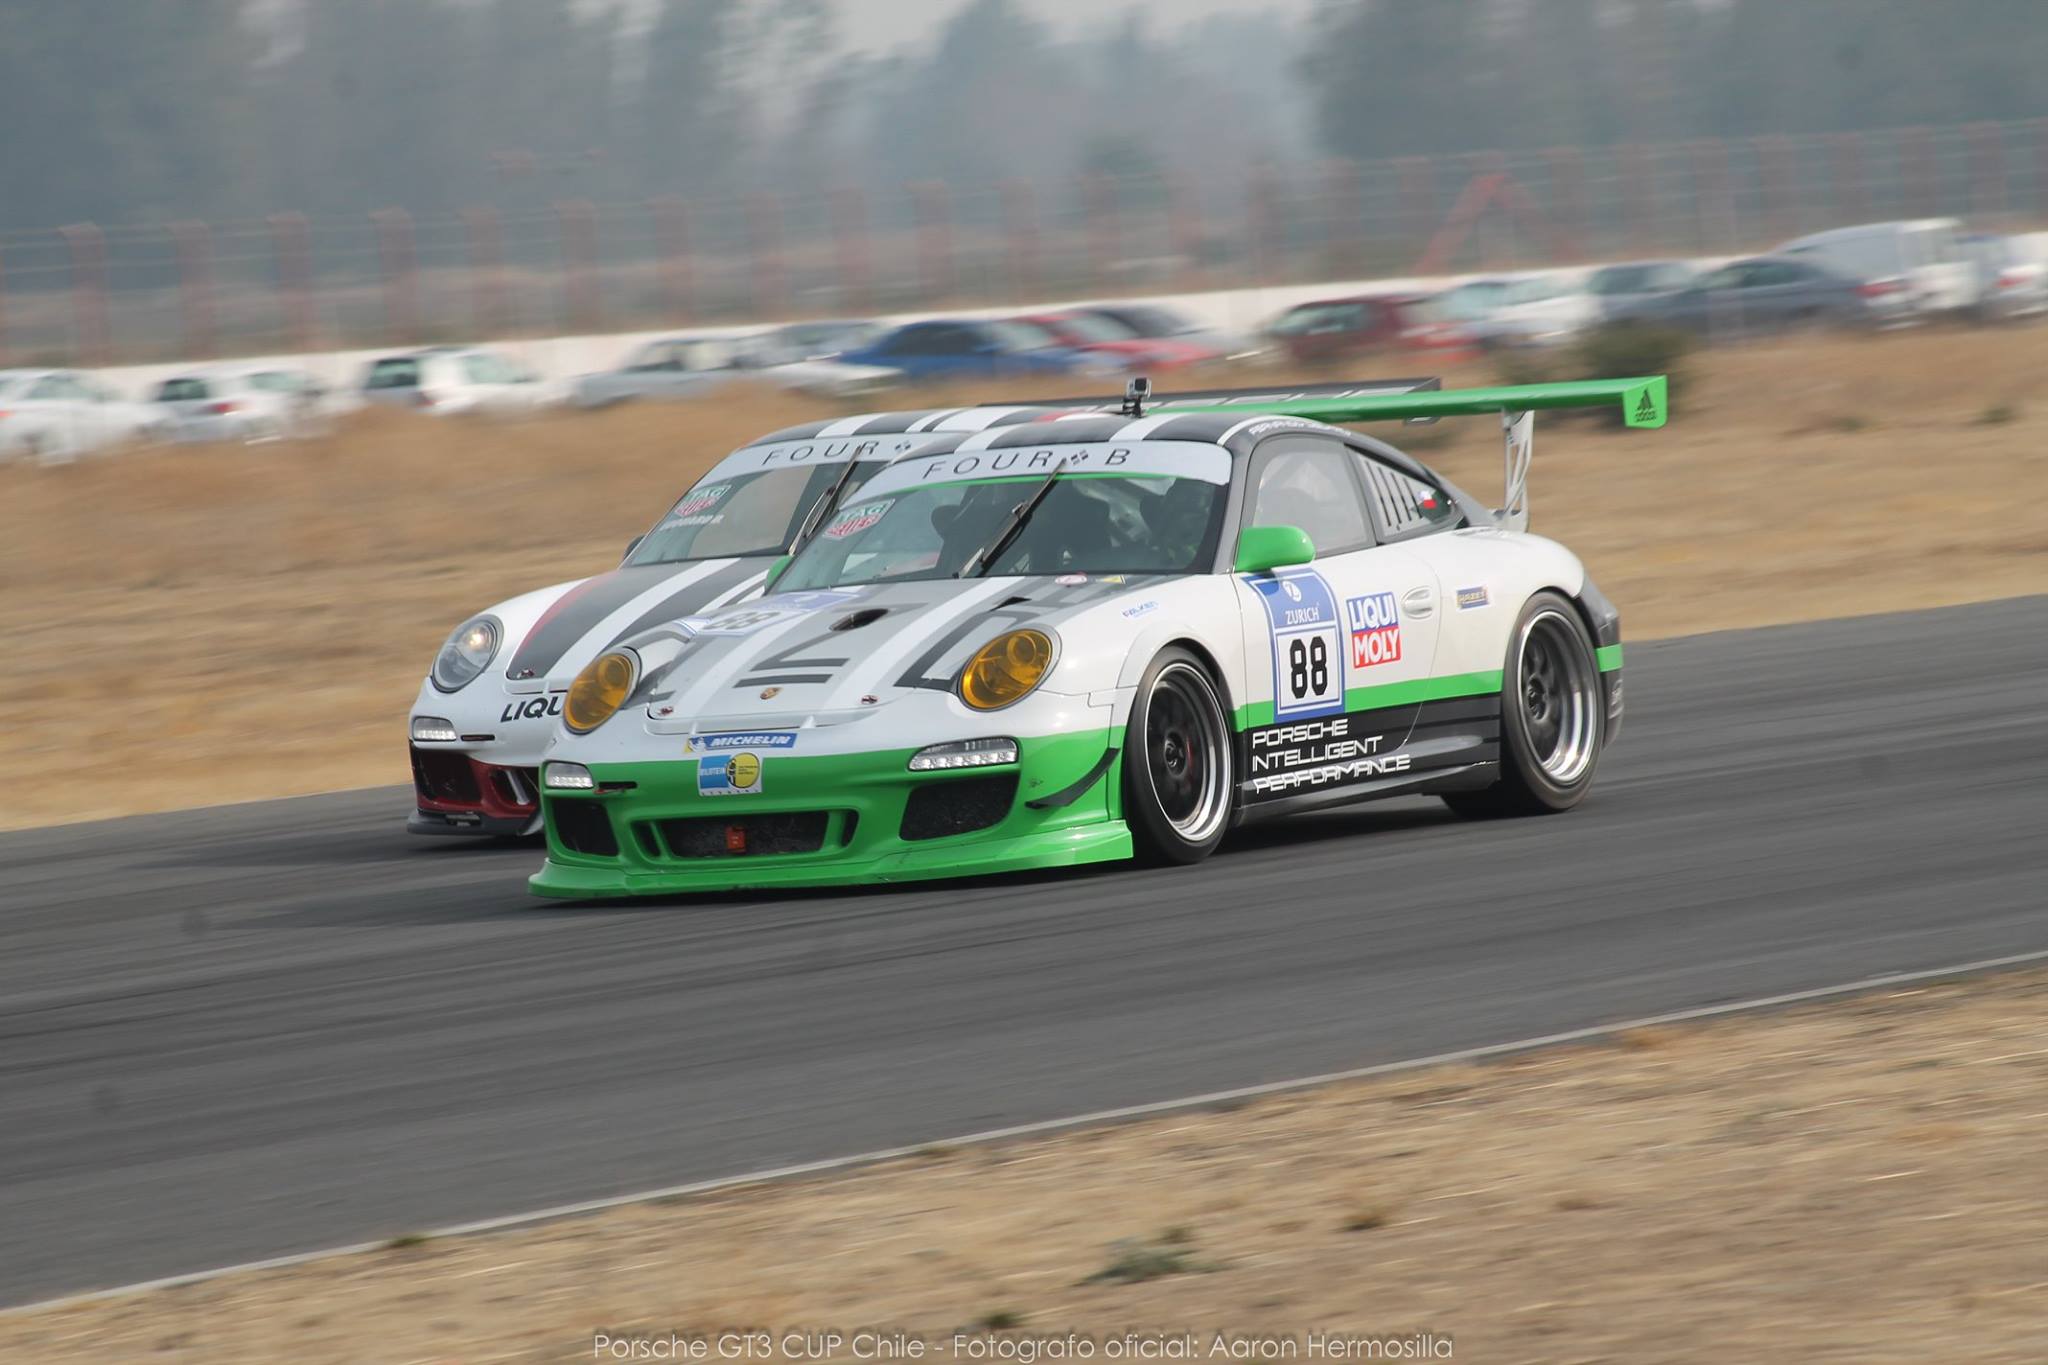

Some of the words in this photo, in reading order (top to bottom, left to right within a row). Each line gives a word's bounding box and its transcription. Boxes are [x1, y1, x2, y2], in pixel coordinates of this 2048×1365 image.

[762, 440, 879, 466] FOUR
[922, 451, 1054, 480] FOUR
[1284, 607, 1321, 625] ZURICH
[1348, 598, 1398, 631] LIQUI
[1354, 629, 1401, 666] MOLY
[1290, 636, 1328, 699] 88
[710, 735, 791, 748] MICHELIN
[1252, 718, 1349, 749] PORSCHE
[1252, 736, 1383, 772] INTELLIGENT
[1252, 754, 1411, 794] PERFORMANCE
